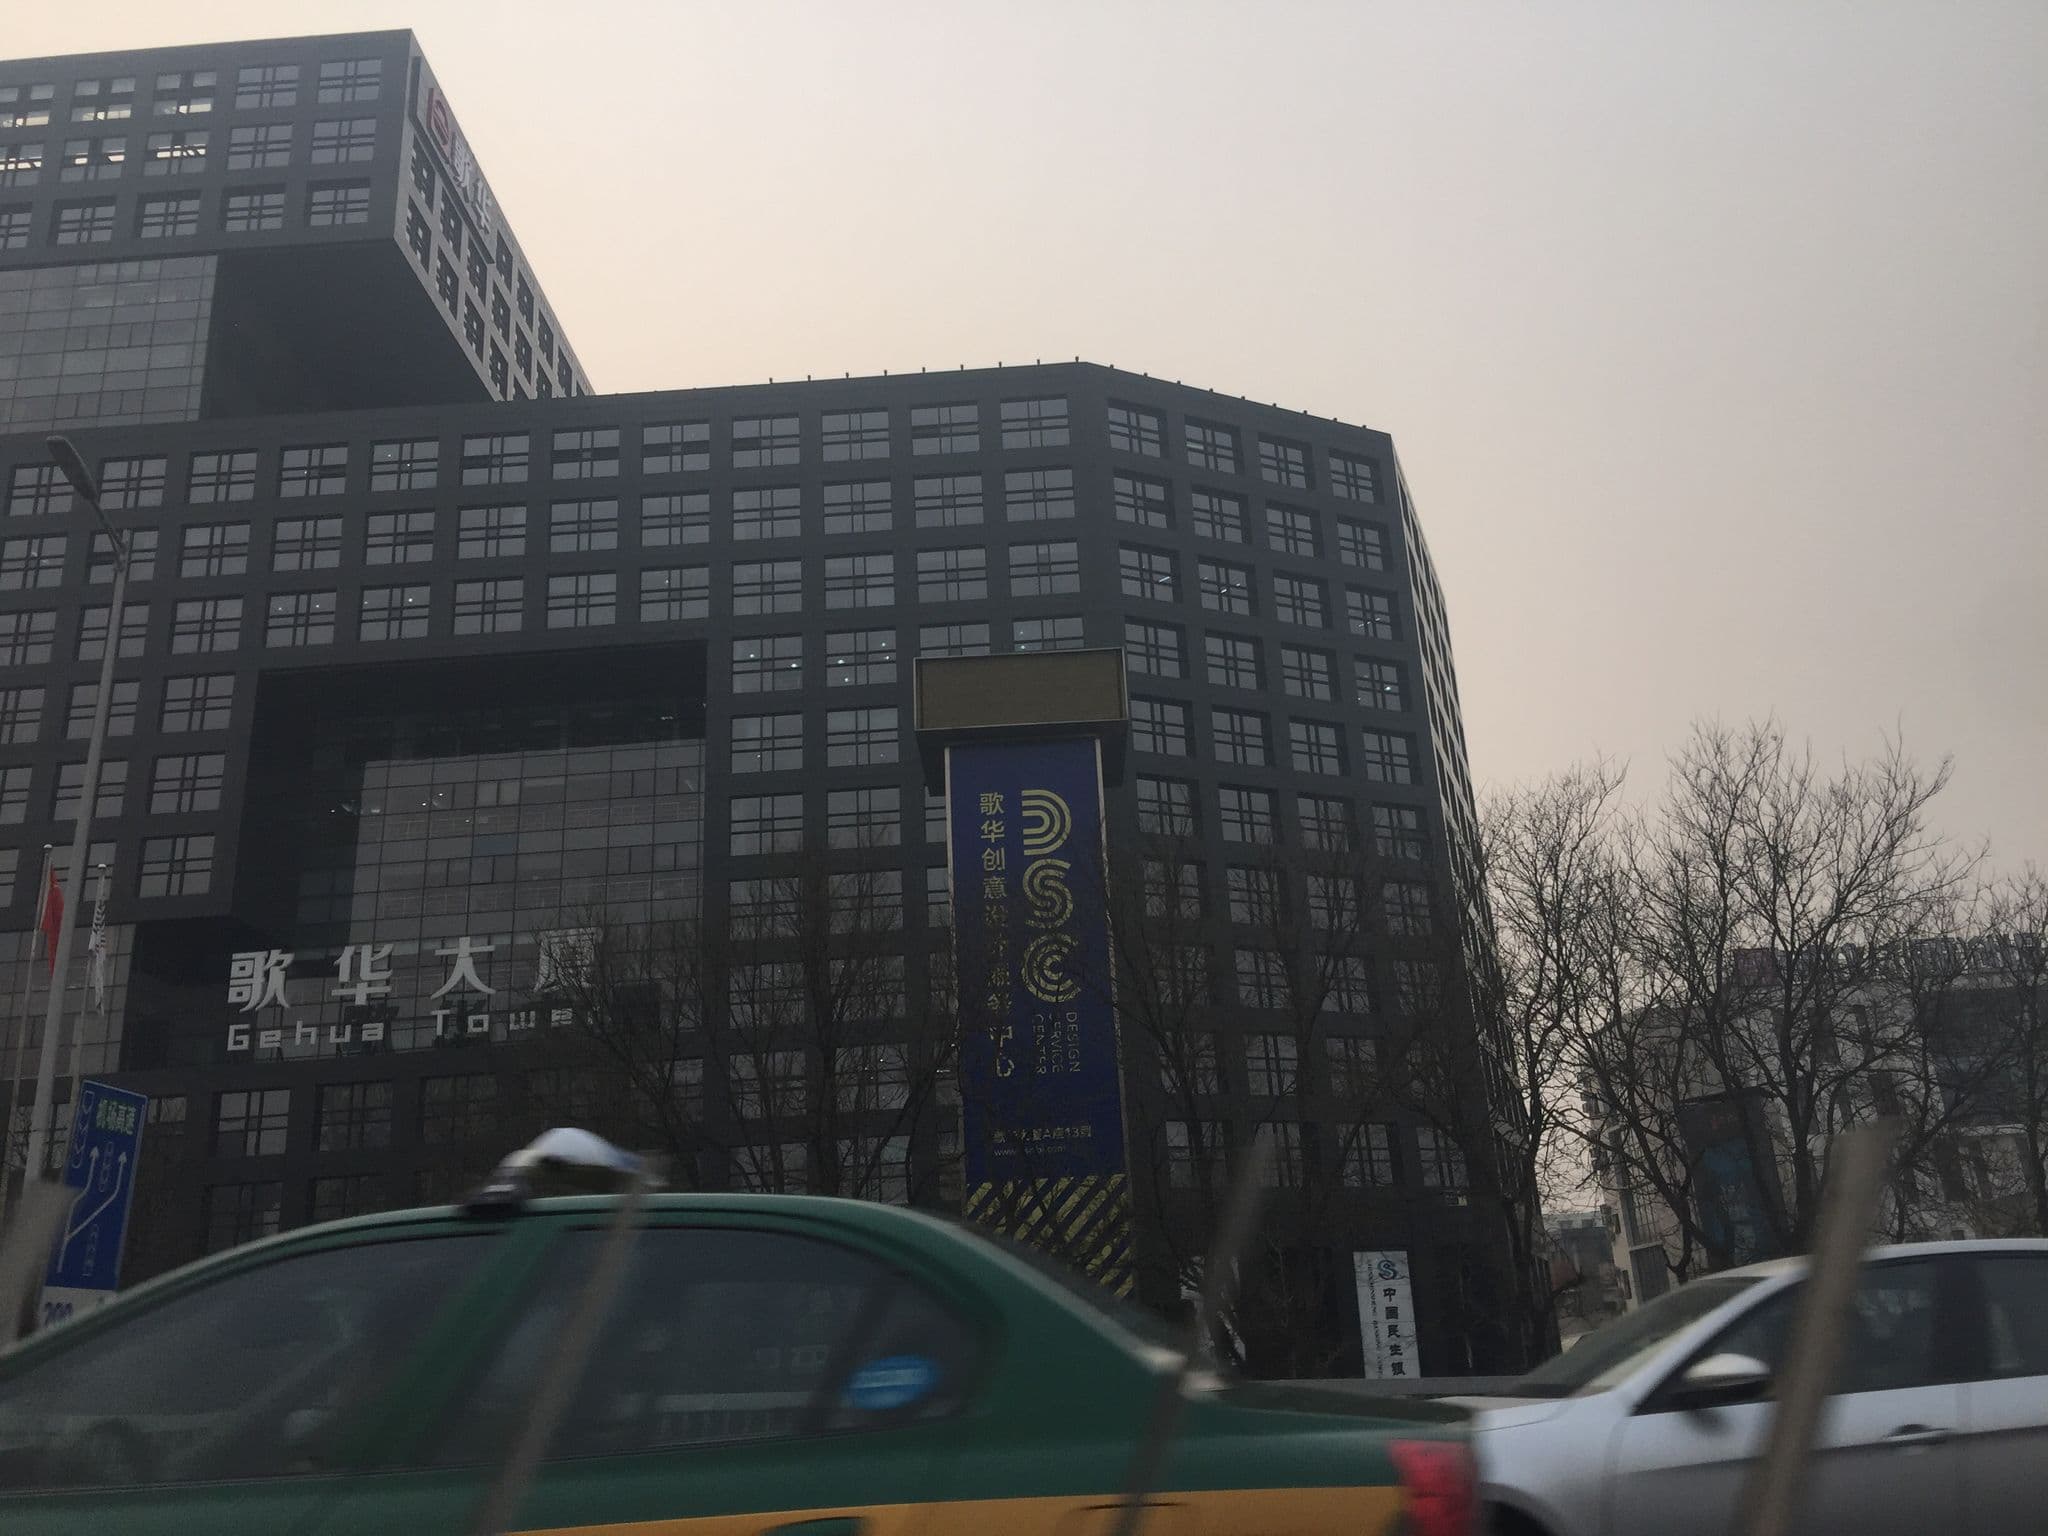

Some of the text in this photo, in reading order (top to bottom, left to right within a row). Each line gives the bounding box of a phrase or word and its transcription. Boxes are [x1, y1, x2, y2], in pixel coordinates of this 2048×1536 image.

[226, 1005, 603, 1052] Gehua Towe
[1048, 1013, 1064, 1073] ERVICE
[1065, 1012, 1081, 1073] DESIGN
